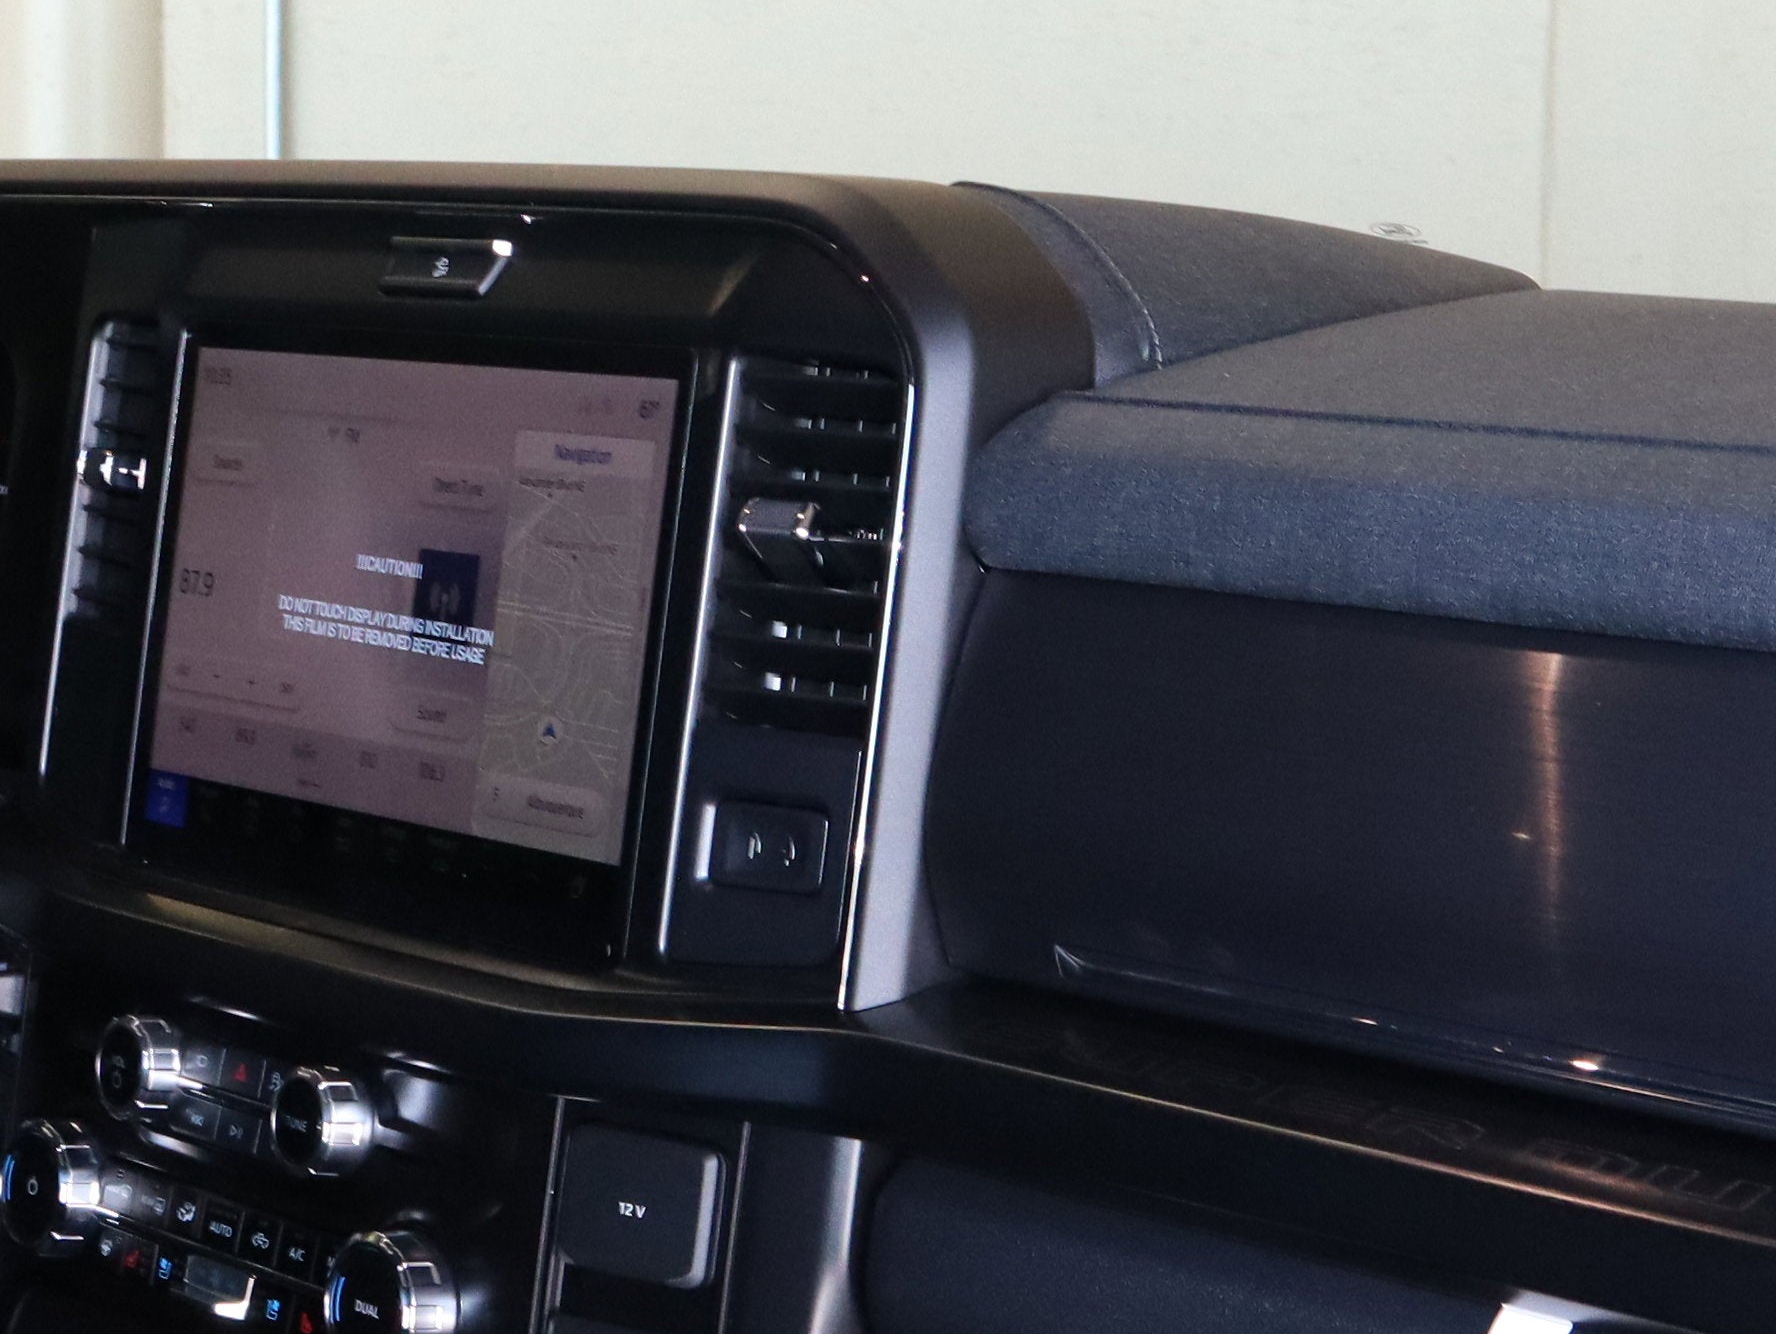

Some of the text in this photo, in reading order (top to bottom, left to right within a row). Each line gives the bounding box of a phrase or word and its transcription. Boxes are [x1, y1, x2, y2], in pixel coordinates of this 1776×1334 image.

[295, 597, 313, 614] NOT
[315, 601, 346, 619] TOUCH
[347, 607, 386, 626] DISPLAY
[388, 613, 424, 634] DURING
[424, 620, 495, 646] INSTALLATION
[283, 614, 305, 631] THIS
[305, 618, 327, 635] FILM
[337, 624, 350, 640] TO
[351, 627, 364, 643] BE
[365, 629, 412, 652] REMOVED
[412, 636, 450, 658] BEFORE
[451, 644, 487, 665] USAGE
[208, 1220, 234, 1238] AUTO
[288, 1246, 307, 1263] A/C
[354, 1298, 381, 1320] DUAL
